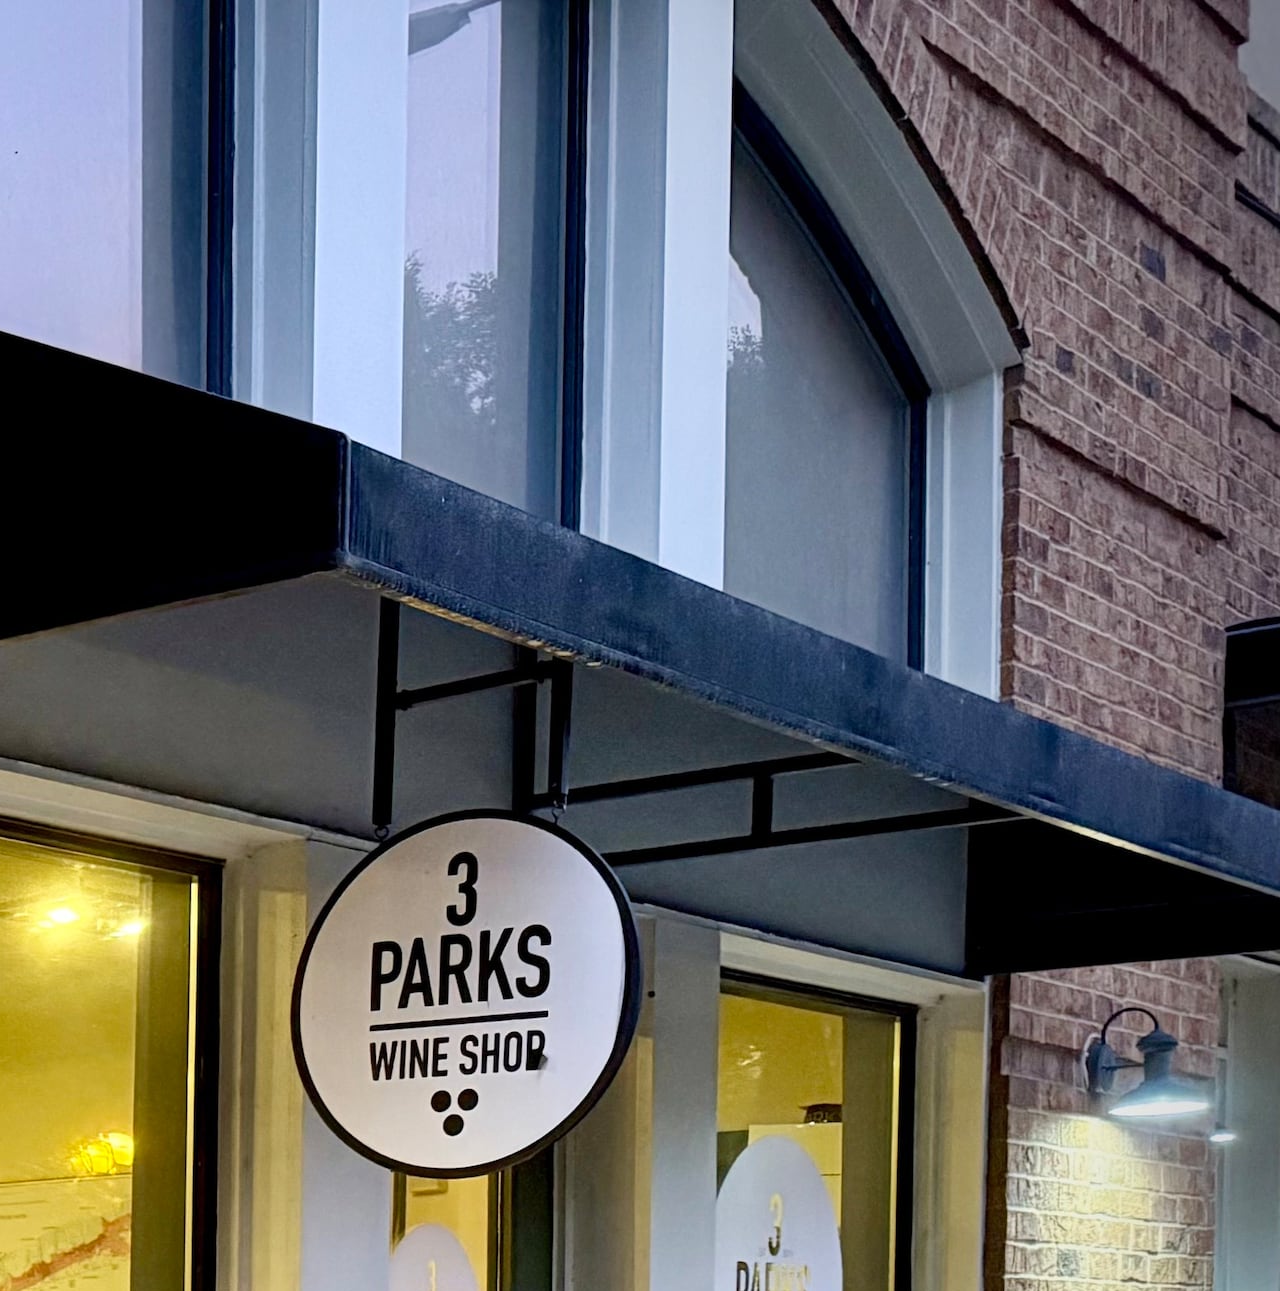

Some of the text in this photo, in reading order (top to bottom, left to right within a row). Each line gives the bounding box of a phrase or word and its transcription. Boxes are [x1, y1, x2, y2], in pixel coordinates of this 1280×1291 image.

[445, 851, 479, 927] 3
[369, 923, 553, 1012] PARKS
[369, 1030, 546, 1081] WINE SHOP
[767, 1192, 783, 1256] 3
